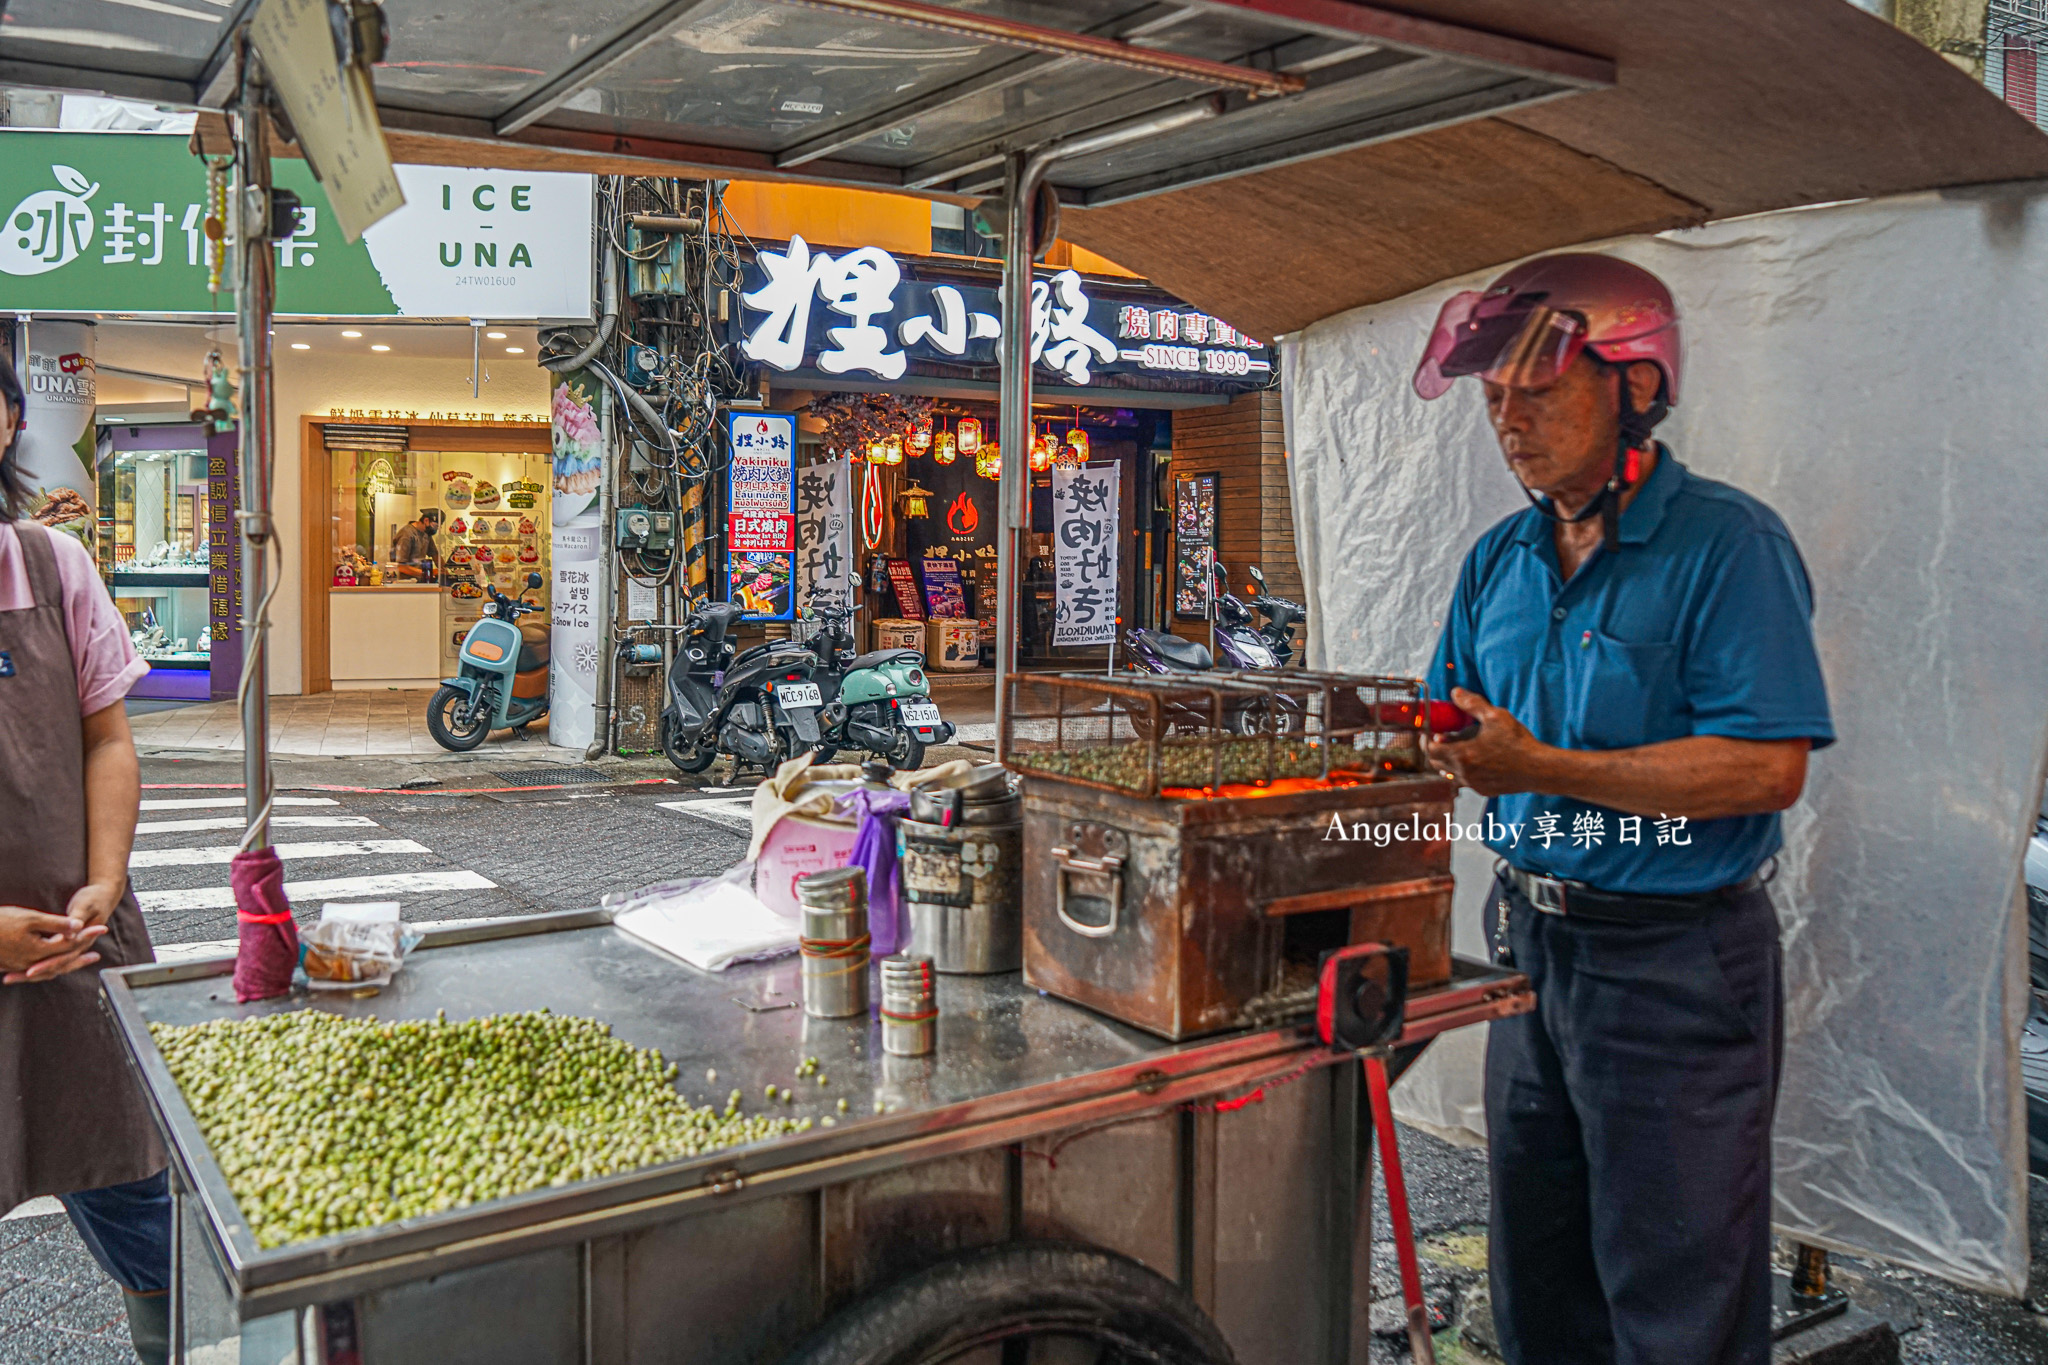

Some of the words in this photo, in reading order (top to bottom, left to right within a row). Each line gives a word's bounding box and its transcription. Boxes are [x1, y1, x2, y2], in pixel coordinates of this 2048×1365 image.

[442, 184, 531, 212] ICE
[439, 242, 533, 268] UNA
[742, 233, 1118, 386] 狸小路
[1146, 346, 1198, 369] SINCE
[1207, 352, 1248, 373] 1999
[735, 433, 789, 450] 狸小路
[734, 456, 788, 467] Yakiniku
[560, 571, 590, 584] 雪花冰
[570, 587, 589, 601] 설빙
[574, 617, 589, 628] Ice
[780, 688, 820, 703] MCC-9168
[904, 708, 940, 722] NSZ-1510
